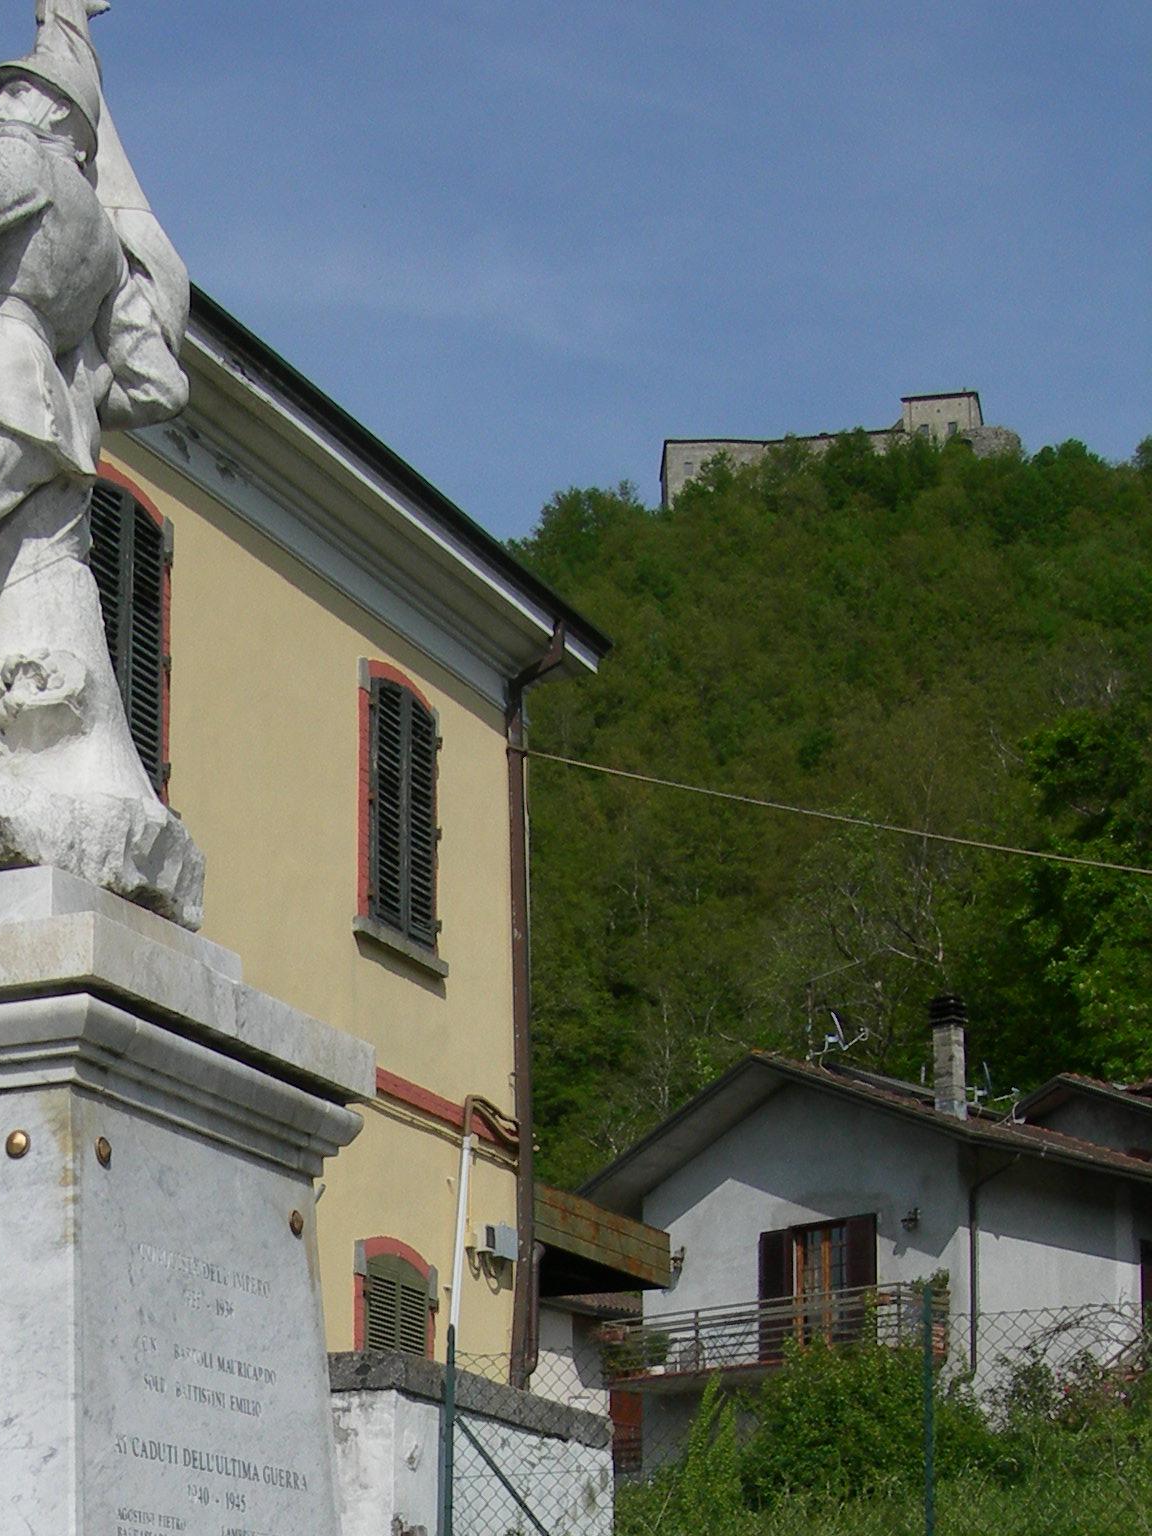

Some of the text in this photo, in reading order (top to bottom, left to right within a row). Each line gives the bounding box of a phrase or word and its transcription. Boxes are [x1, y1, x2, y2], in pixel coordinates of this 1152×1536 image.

[132, 1437, 179, 1465] CADUTI
[183, 1447, 260, 1482] DELL'ULTIMA
[263, 1465, 308, 1491] GUERRA
